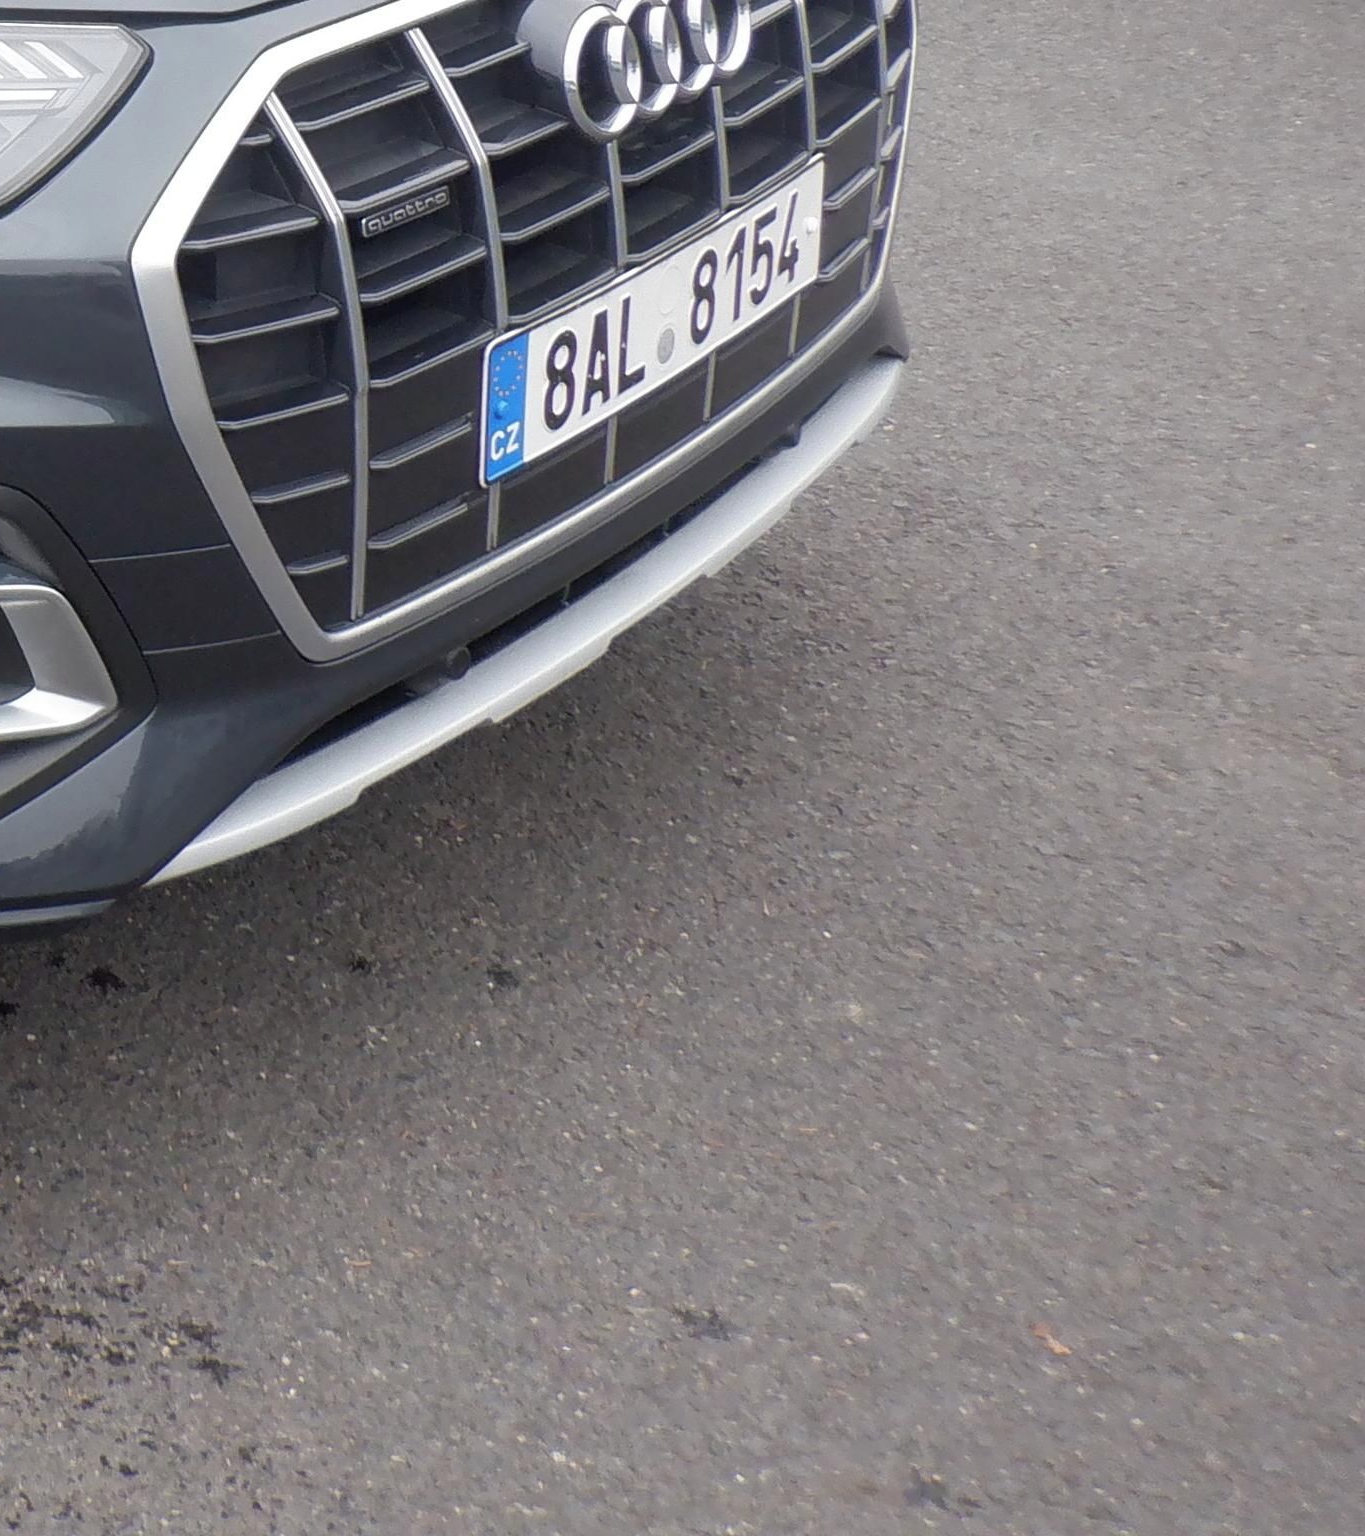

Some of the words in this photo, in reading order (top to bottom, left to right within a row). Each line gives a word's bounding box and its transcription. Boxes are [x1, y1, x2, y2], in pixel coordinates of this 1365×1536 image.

[367, 191, 448, 232] quattro
[544, 294, 647, 432] 8AL
[689, 188, 800, 346] 8154
[490, 420, 521, 462] CZ
